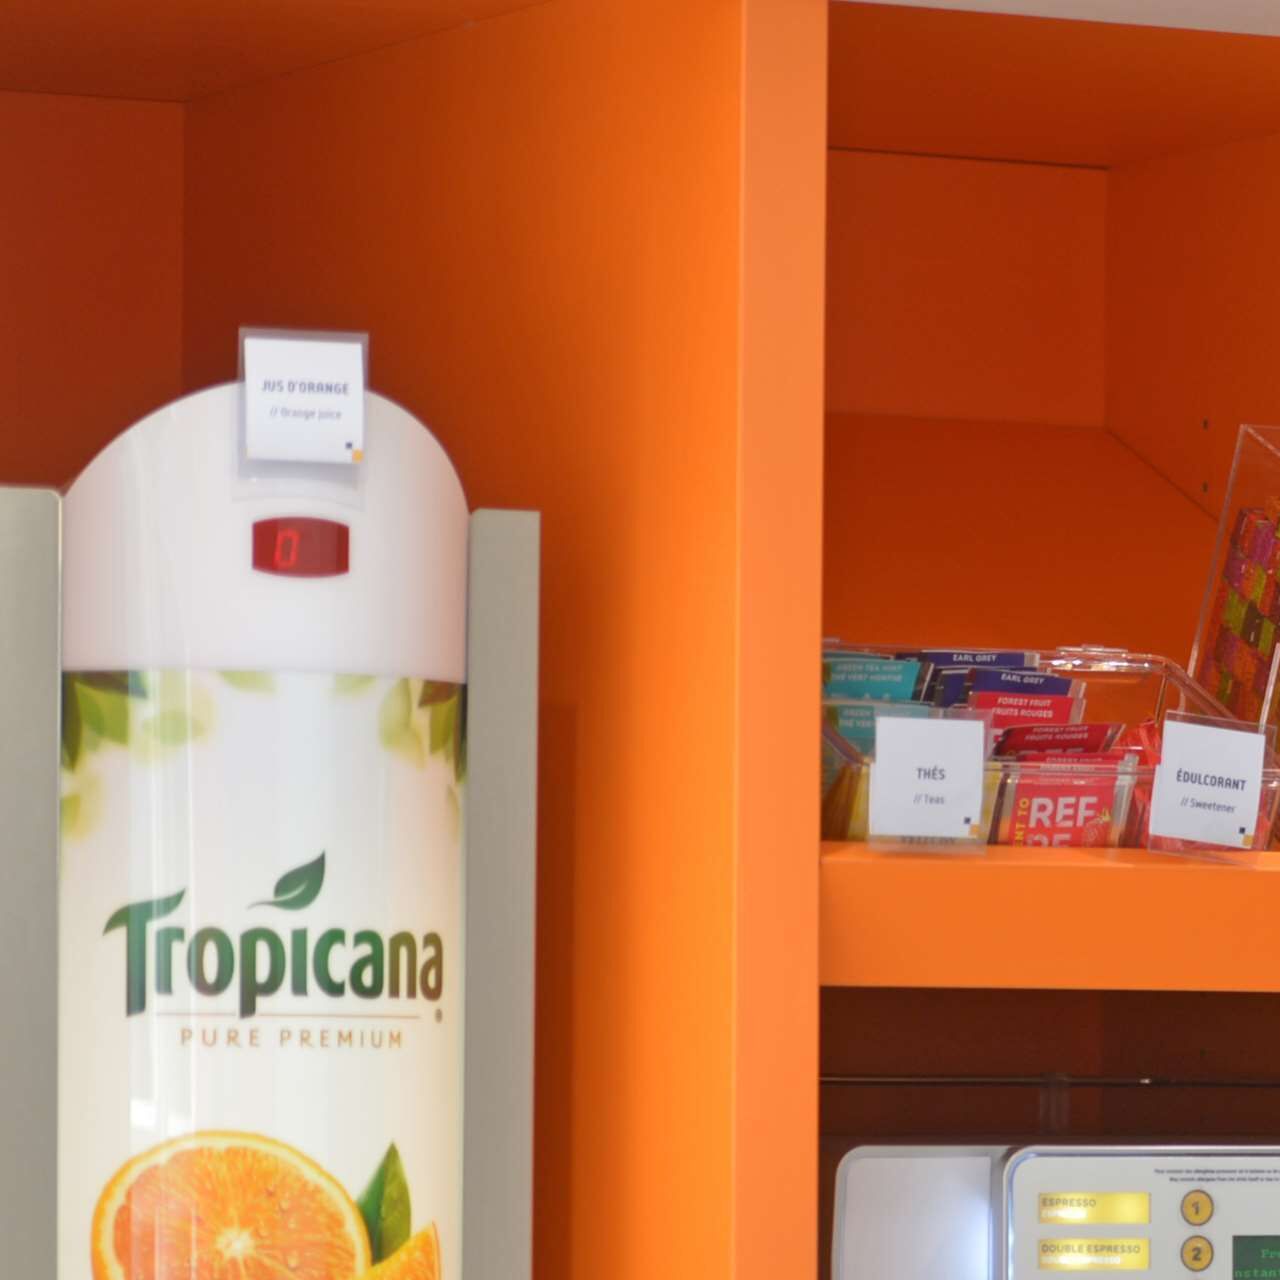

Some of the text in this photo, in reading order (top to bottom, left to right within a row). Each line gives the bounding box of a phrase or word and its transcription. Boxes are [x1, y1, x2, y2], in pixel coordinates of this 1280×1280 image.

[262, 380, 350, 396] JUS D'ORANGE
[953, 654, 997, 662] EARL GREY
[1001, 673, 1044, 684] EARL GREY
[997, 697, 1052, 706] FOREST FRUIT
[1020, 709, 1053, 718] ROUGES
[917, 766, 946, 780] THÉS
[1176, 768, 1247, 791] ÉDULCORANT
[924, 794, 945, 805] Teas
[1189, 799, 1235, 814] Sweetener
[1028, 796, 1098, 828] REF
[102, 886, 444, 1019] Tropicana
[181, 1028, 403, 1049] PURE PREMIUM
[1041, 1197, 1096, 1208] ESPRESSO
[1192, 1202, 1200, 1216] 1
[1041, 1244, 1140, 1254] DOUBLE ESPRESSO
[1191, 1247, 1202, 1261] 2
